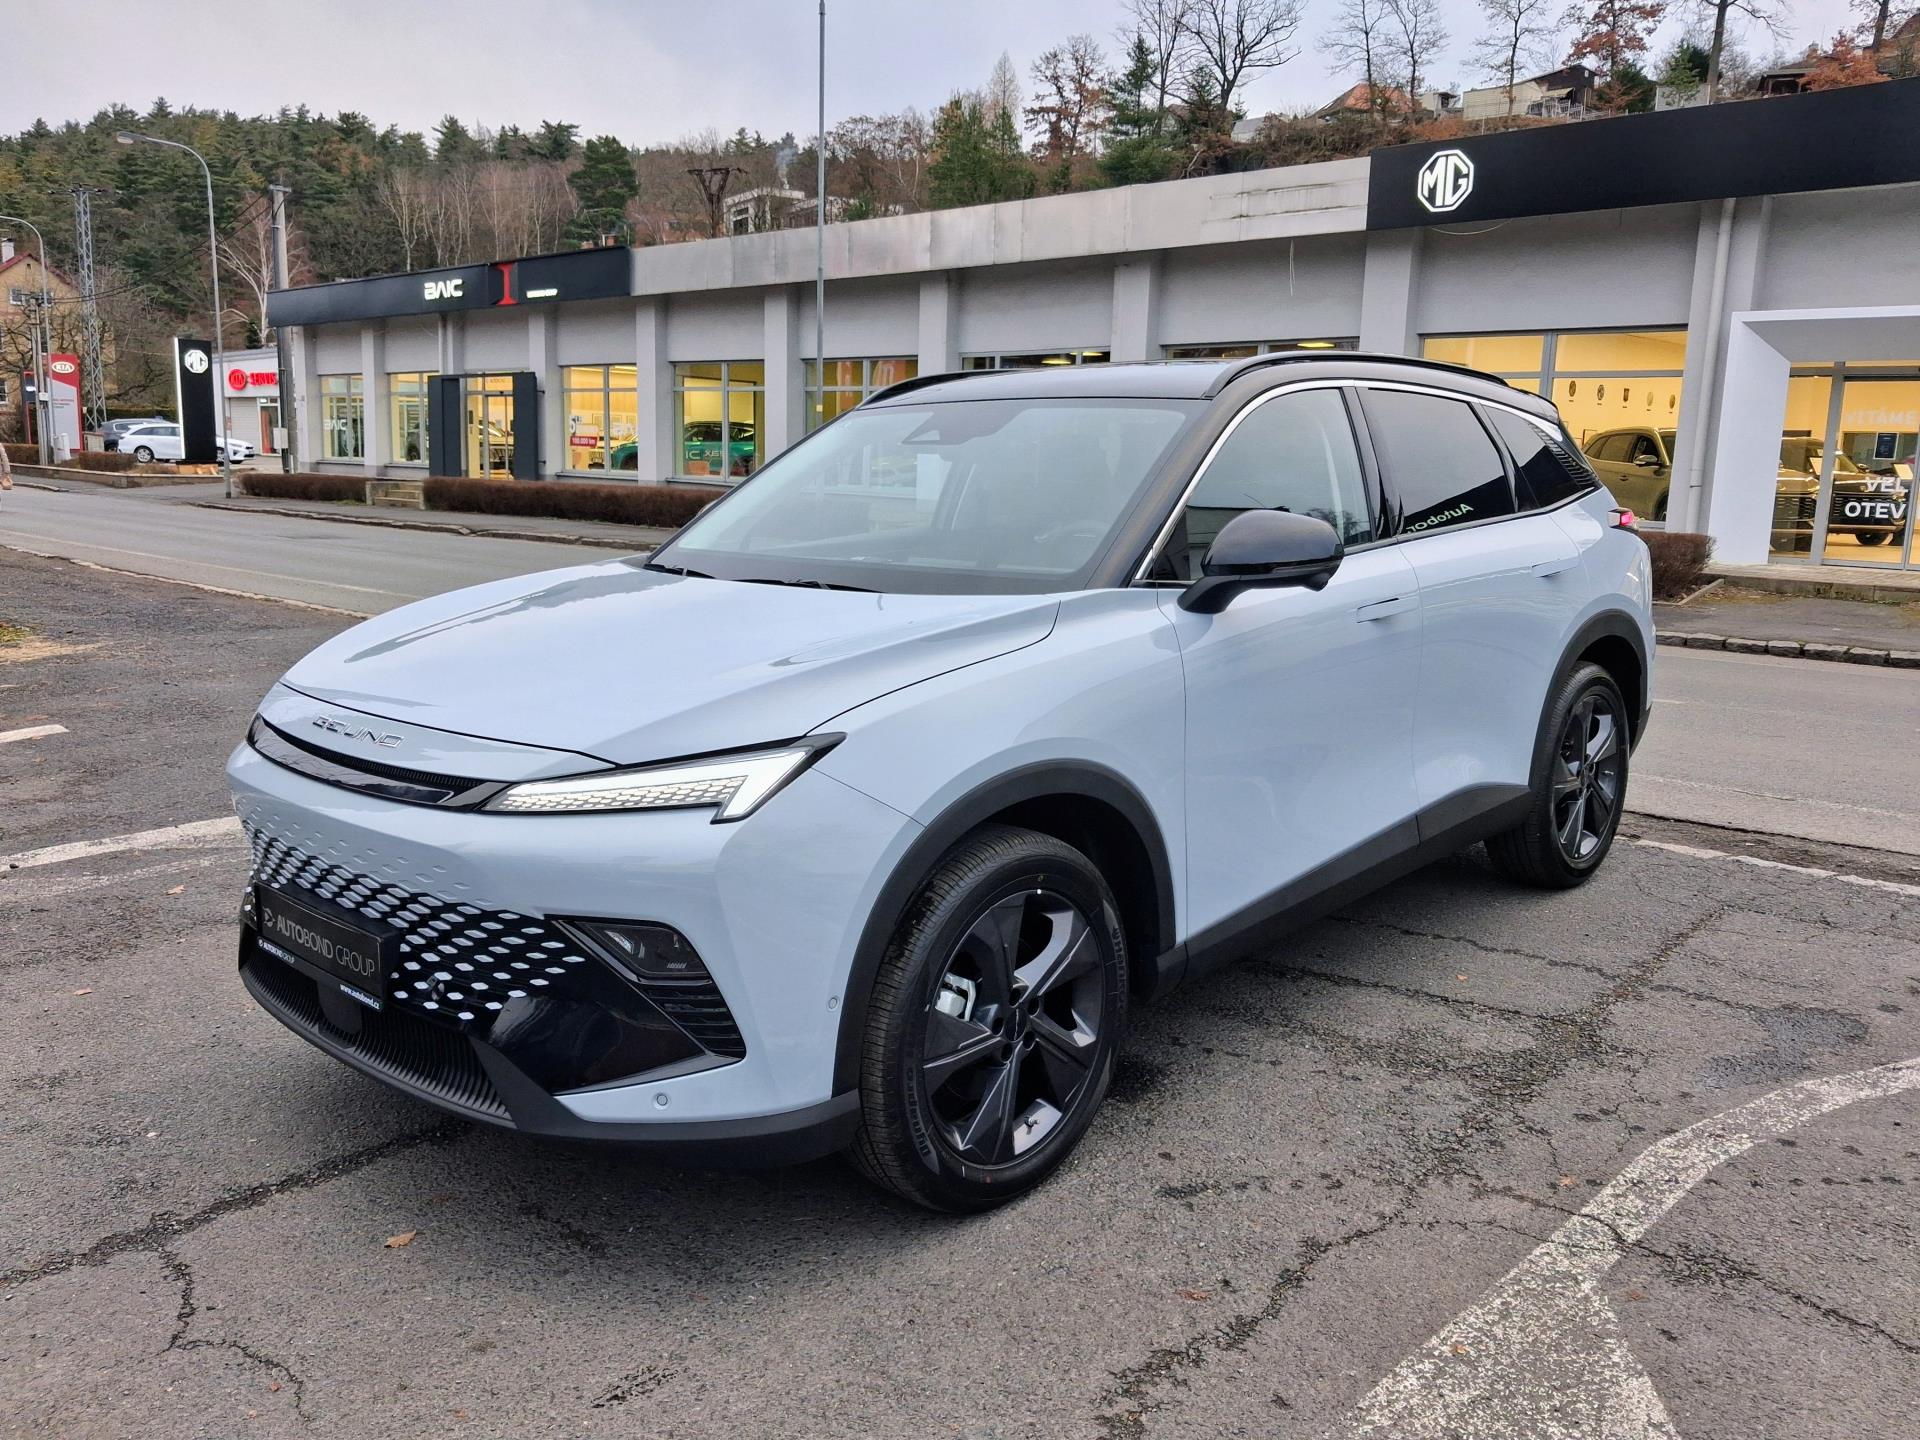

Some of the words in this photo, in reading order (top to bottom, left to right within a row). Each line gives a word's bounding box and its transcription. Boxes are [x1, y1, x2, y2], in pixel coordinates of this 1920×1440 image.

[1420, 152, 1472, 209] MG
[424, 279, 463, 300] BAIC
[186, 351, 207, 372] MG
[1845, 501, 1907, 518] OTEV
[276, 914, 334, 959] AUTOBOND
[335, 945, 375, 977] GROUP
